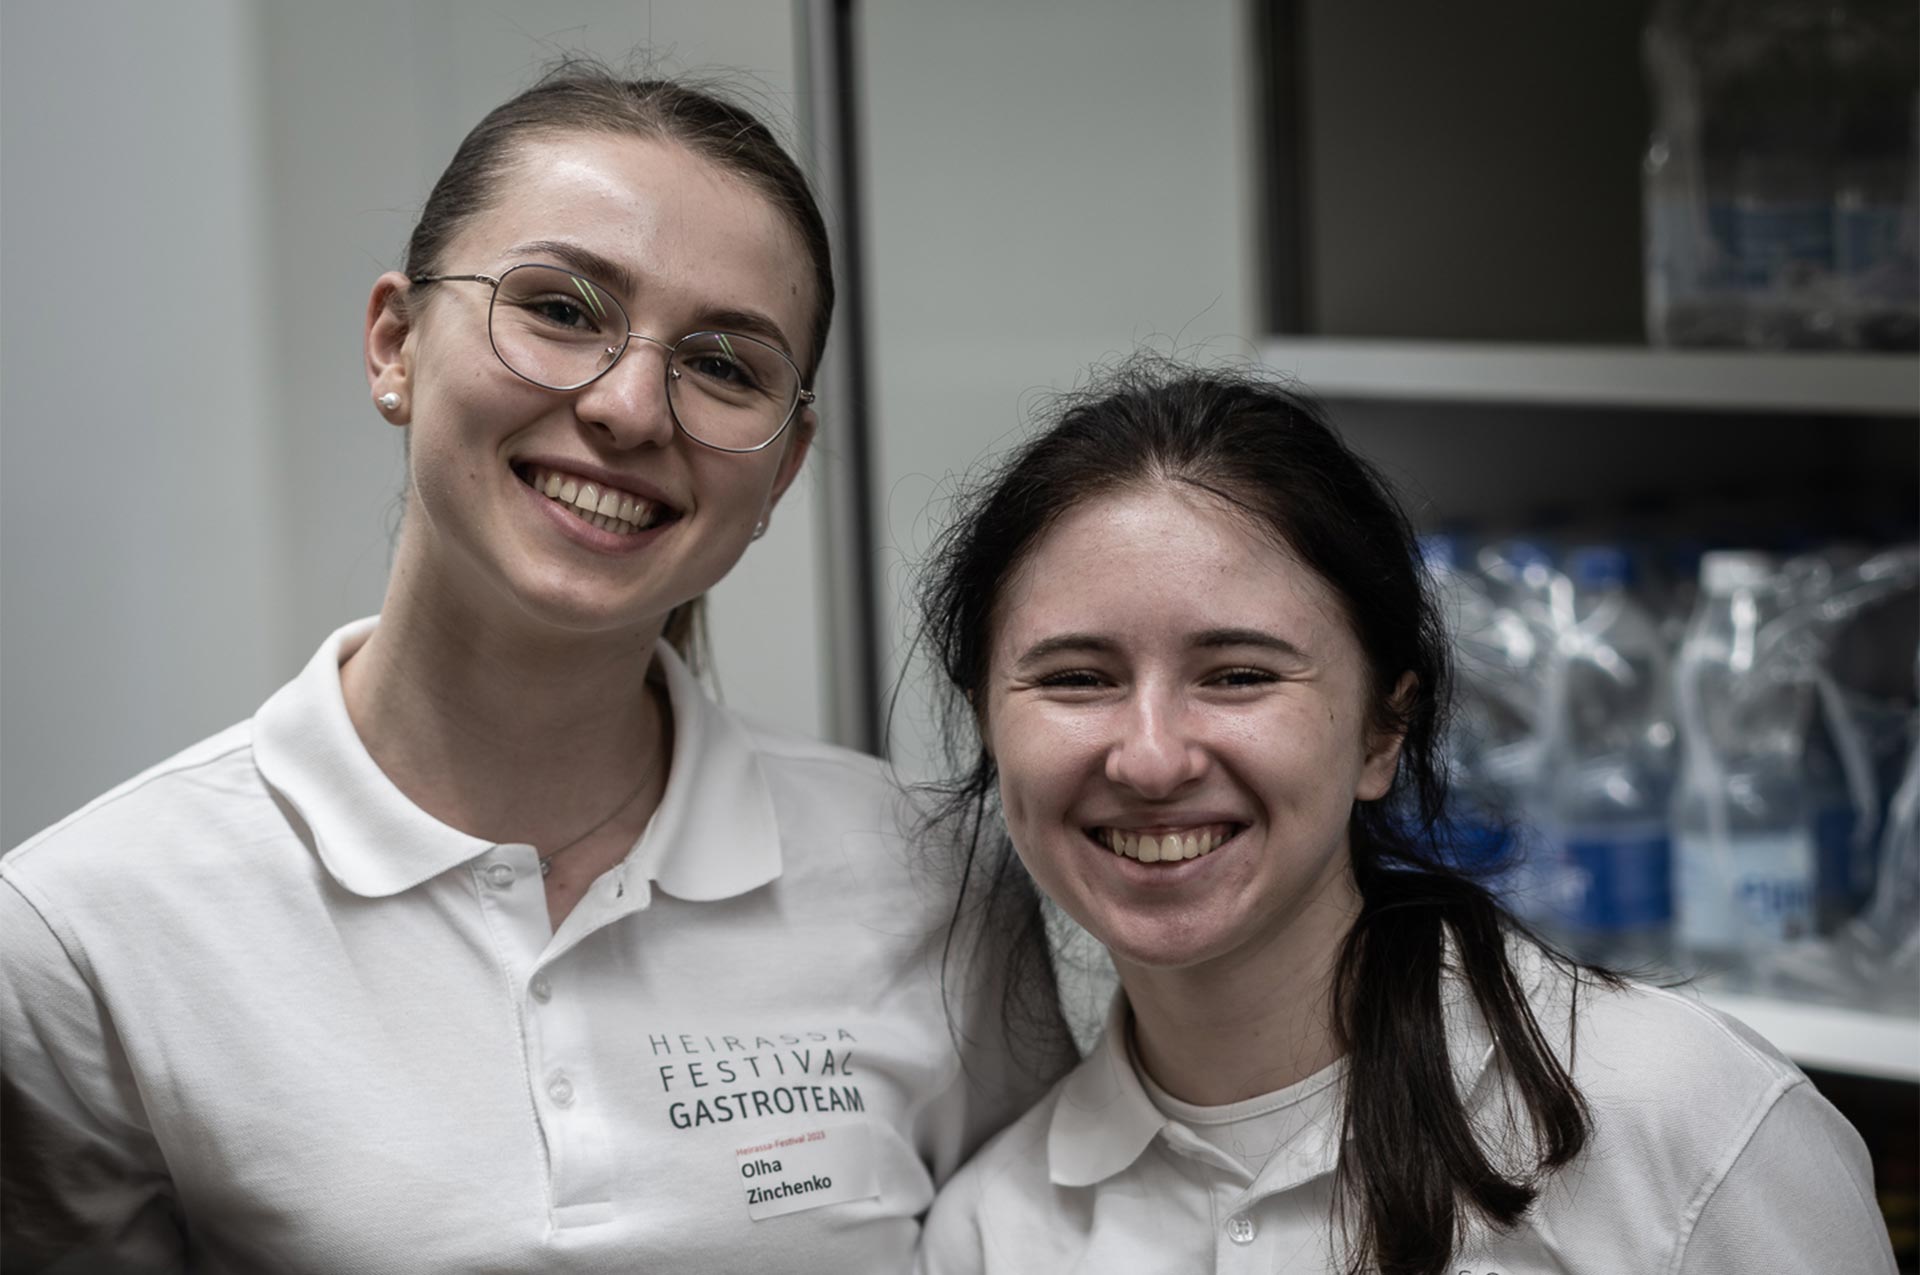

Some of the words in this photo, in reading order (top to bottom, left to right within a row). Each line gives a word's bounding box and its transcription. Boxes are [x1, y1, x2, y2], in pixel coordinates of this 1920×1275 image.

[649, 1029, 856, 1055] HEIRASSA
[660, 1049, 853, 1091] FESTIVAL
[669, 1086, 865, 1129] GASTROTEAM
[741, 1158, 782, 1178] Olha
[747, 1175, 832, 1204] Zinchenko
